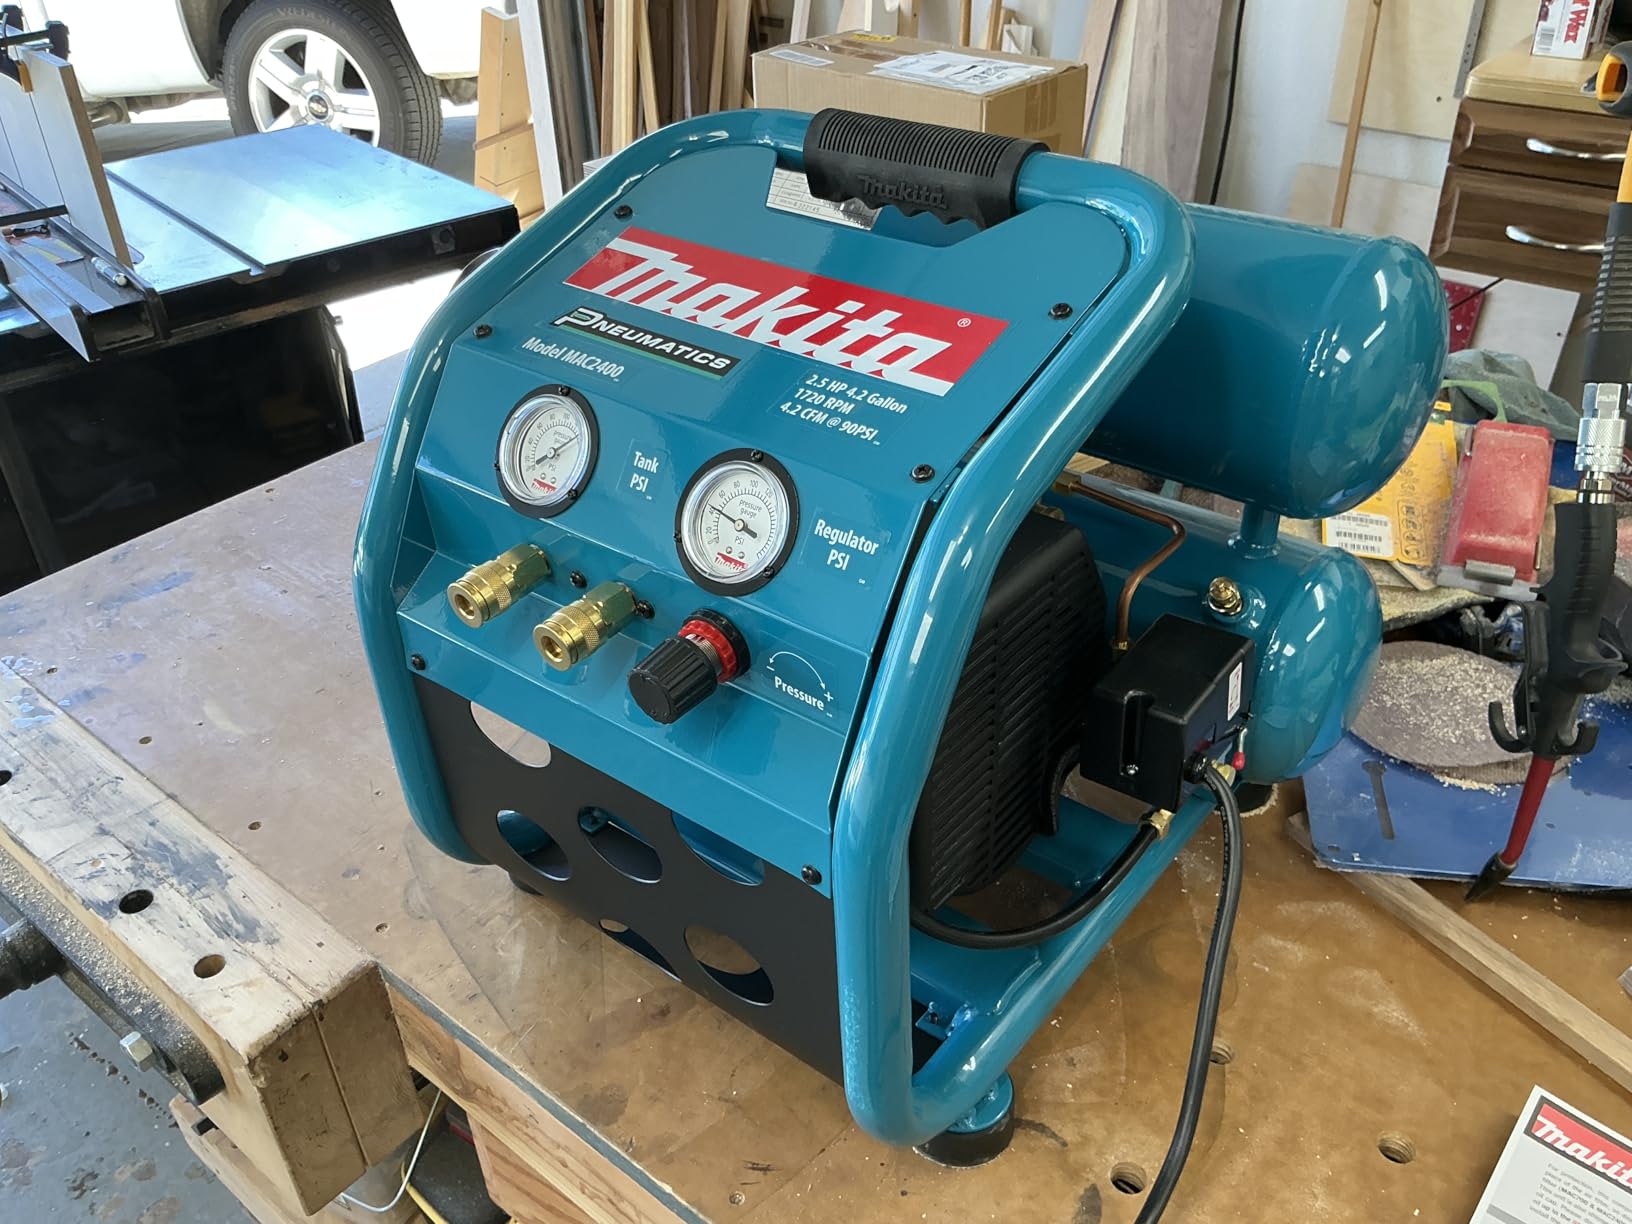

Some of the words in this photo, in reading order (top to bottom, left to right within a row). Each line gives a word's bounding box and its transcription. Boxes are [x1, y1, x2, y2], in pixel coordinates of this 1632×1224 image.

[554, 307, 731, 370] PNEUMATICS
[522, 337, 566, 359] Model
[563, 349, 625, 378] MAC2400
[794, 388, 826, 405] 1720
[823, 397, 856, 415] RPM
[805, 374, 829, 388] 2.5
[826, 380, 848, 394] HP
[846, 387, 868, 401] 4.2
[867, 393, 908, 414] Gallon
[780, 401, 802, 416] 4.2
[800, 408, 829, 424] CFM
[826, 417, 842, 428] @
[838, 421, 879, 441] 90PSI
[633, 451, 659, 474] Tank
[630, 473, 649, 493] PSI
[739, 500, 762, 513] pressure
[740, 508, 757, 519] gauge
[735, 536, 744, 545] PSI
[814, 519, 880, 555] Regulator
[827, 549, 850, 571] PSI
[774, 675, 825, 711] Pressure
